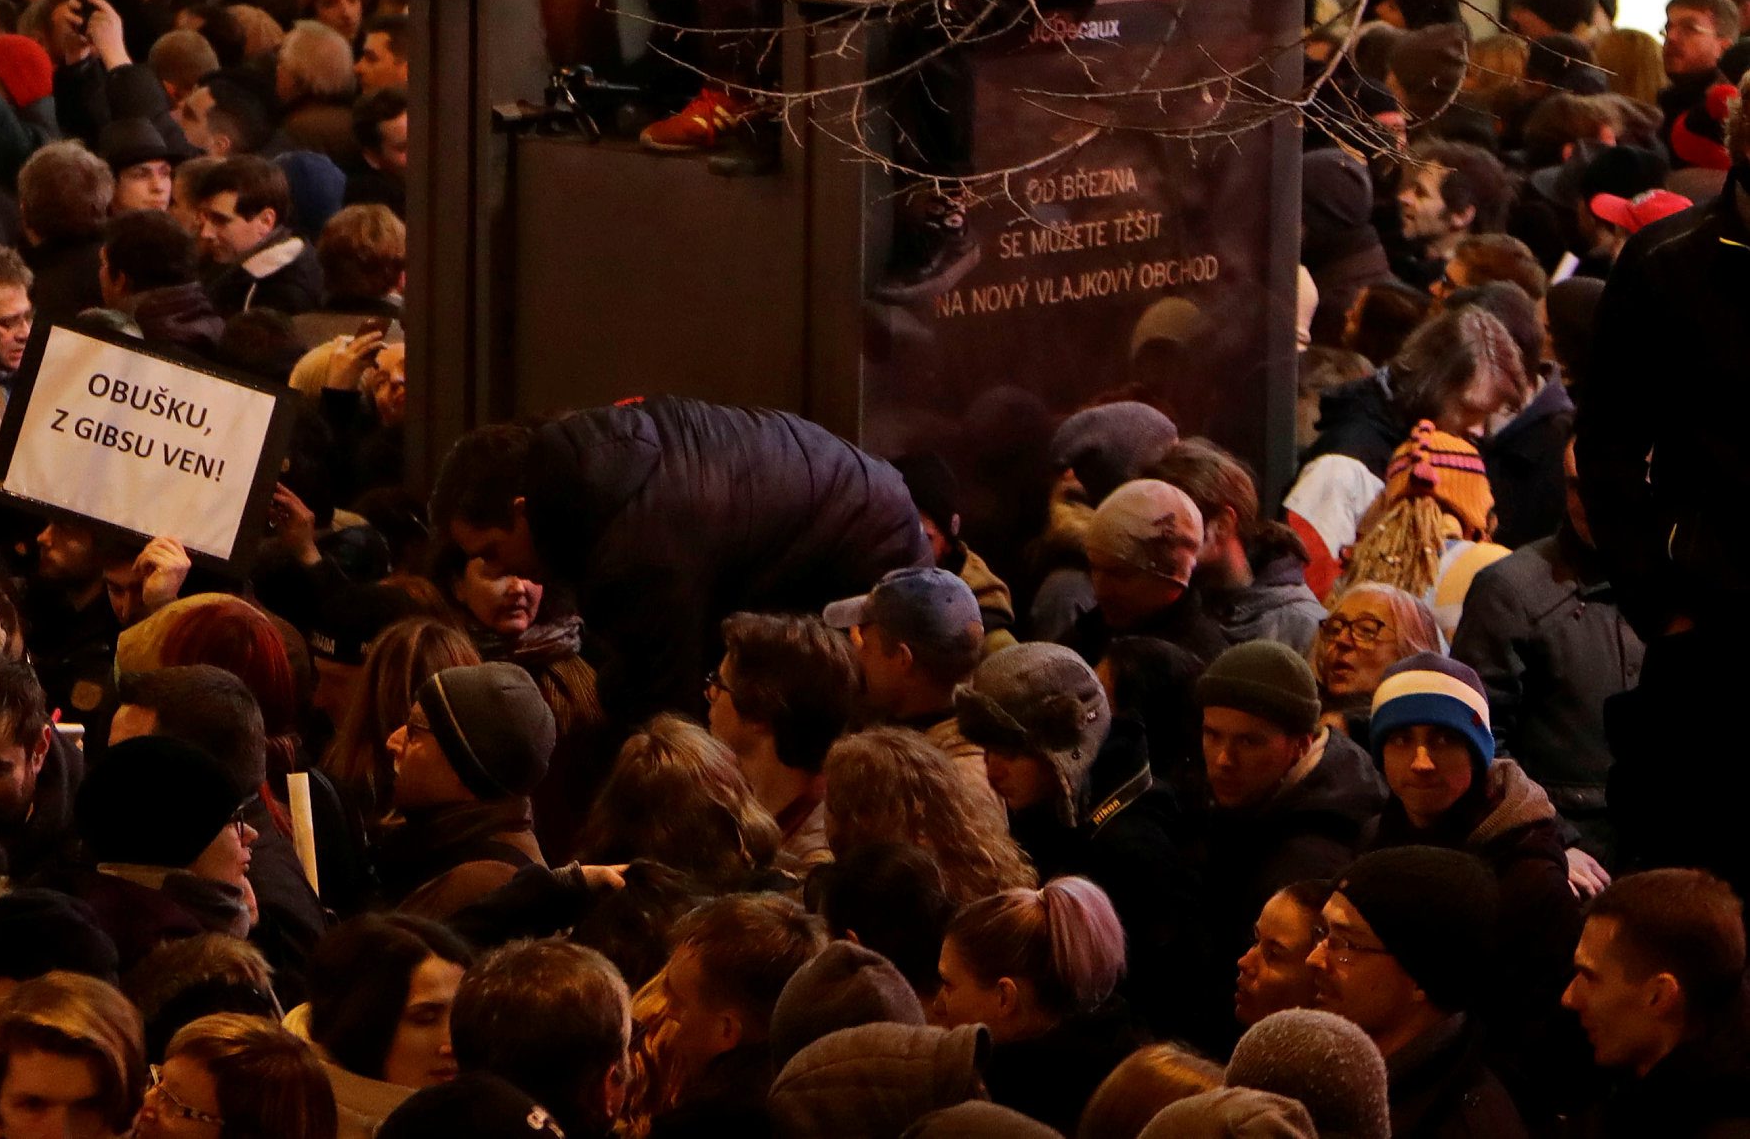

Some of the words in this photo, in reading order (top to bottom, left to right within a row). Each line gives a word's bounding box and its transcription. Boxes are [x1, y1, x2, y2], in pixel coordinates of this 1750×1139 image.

[1027, 178, 1056, 205] OD
[1063, 167, 1138, 201] BŘEZNA
[1000, 231, 1024, 260] SE
[1030, 216, 1107, 255] MŮŽETE
[1114, 210, 1163, 243] TĚŠIT
[935, 291, 966, 319] NA
[972, 276, 1029, 312] NOVÝ
[1035, 261, 1135, 305] VLAJKOVÝ
[1139, 254, 1219, 290] OBCHOD
[87, 372, 212, 437] OBUŠKU,
[50, 408, 67, 432] Z
[73, 418, 155, 458] GIBSU
[162, 443, 225, 482] VEN!
[1092, 798, 1121, 826] Nikon
